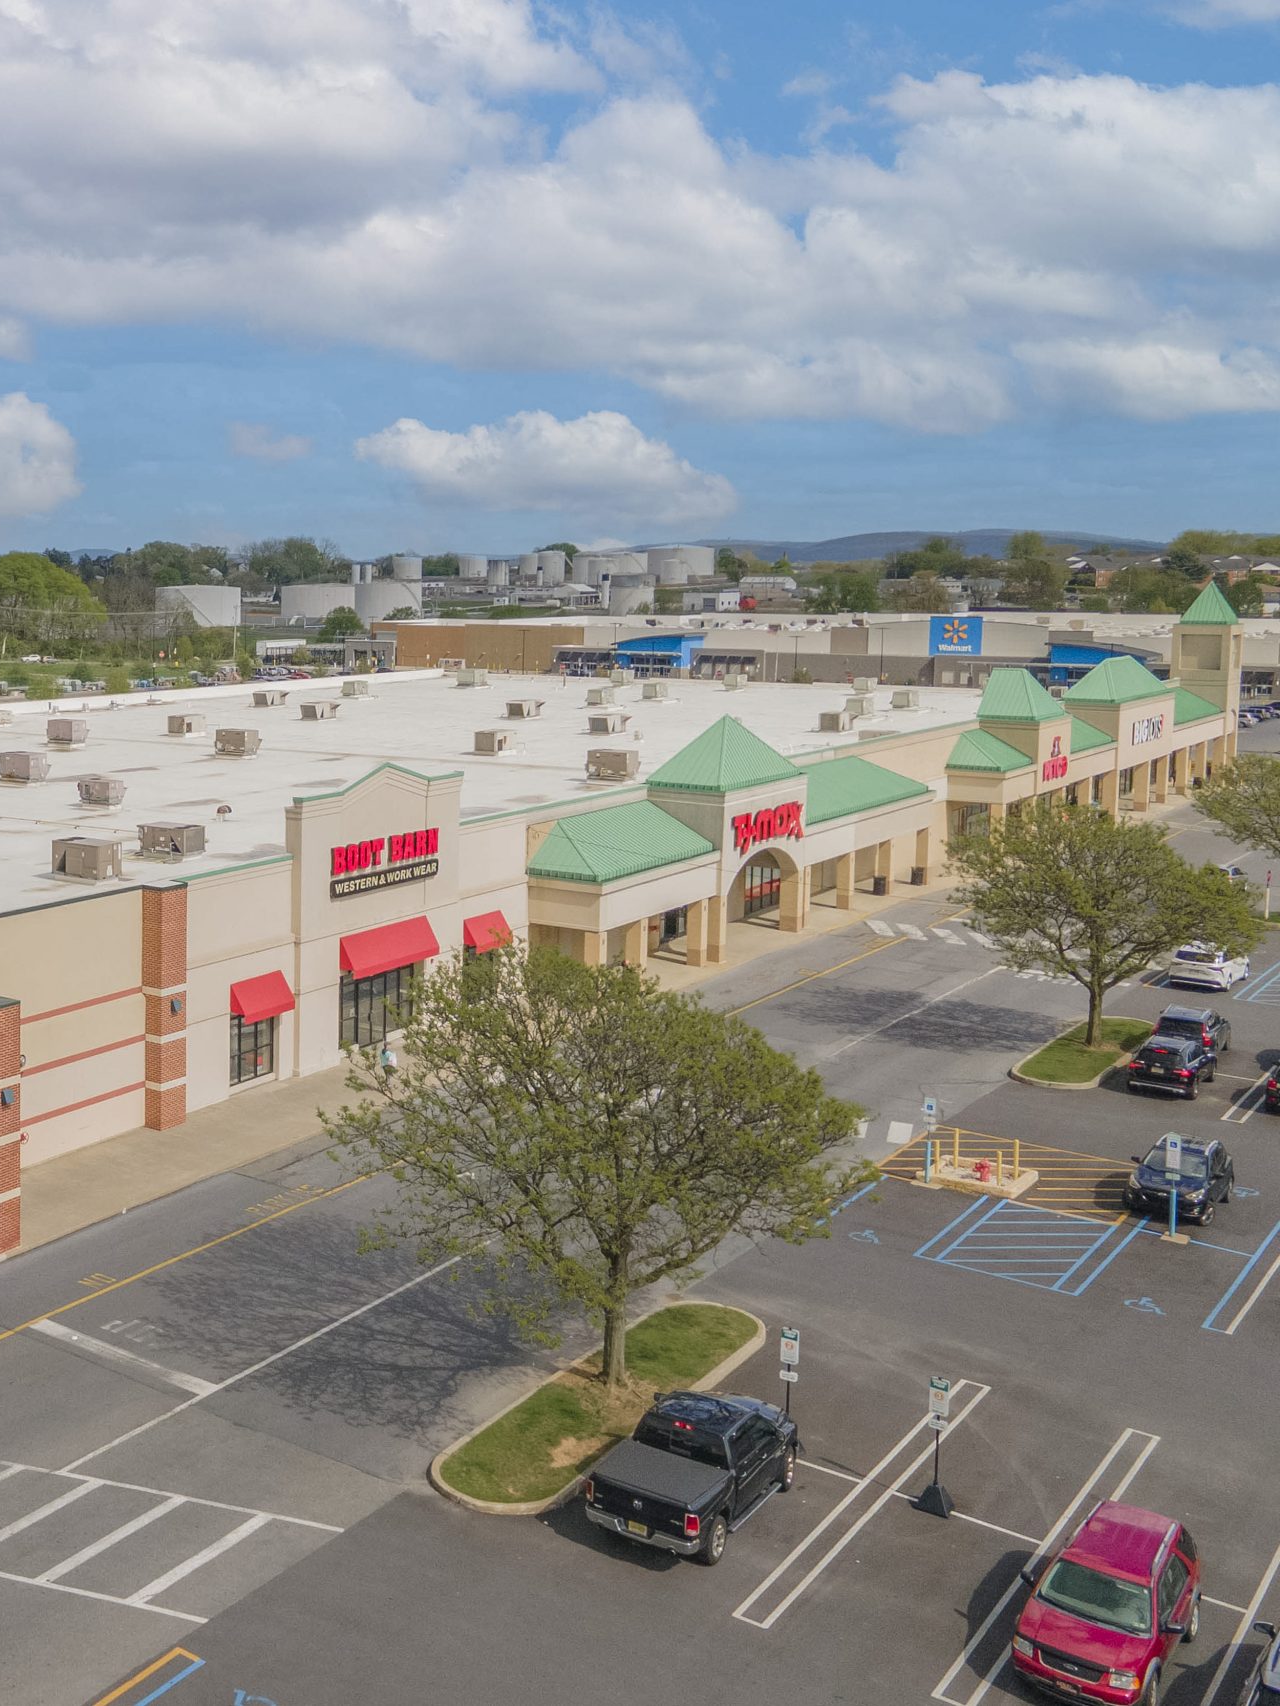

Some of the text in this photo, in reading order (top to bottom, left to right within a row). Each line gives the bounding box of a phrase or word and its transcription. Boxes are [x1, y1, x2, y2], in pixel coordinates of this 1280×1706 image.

[938, 644, 972, 652] Walmart
[331, 828, 439, 876] BOOT BARN
[334, 862, 437, 895] WESTERN & WORK WEAR
